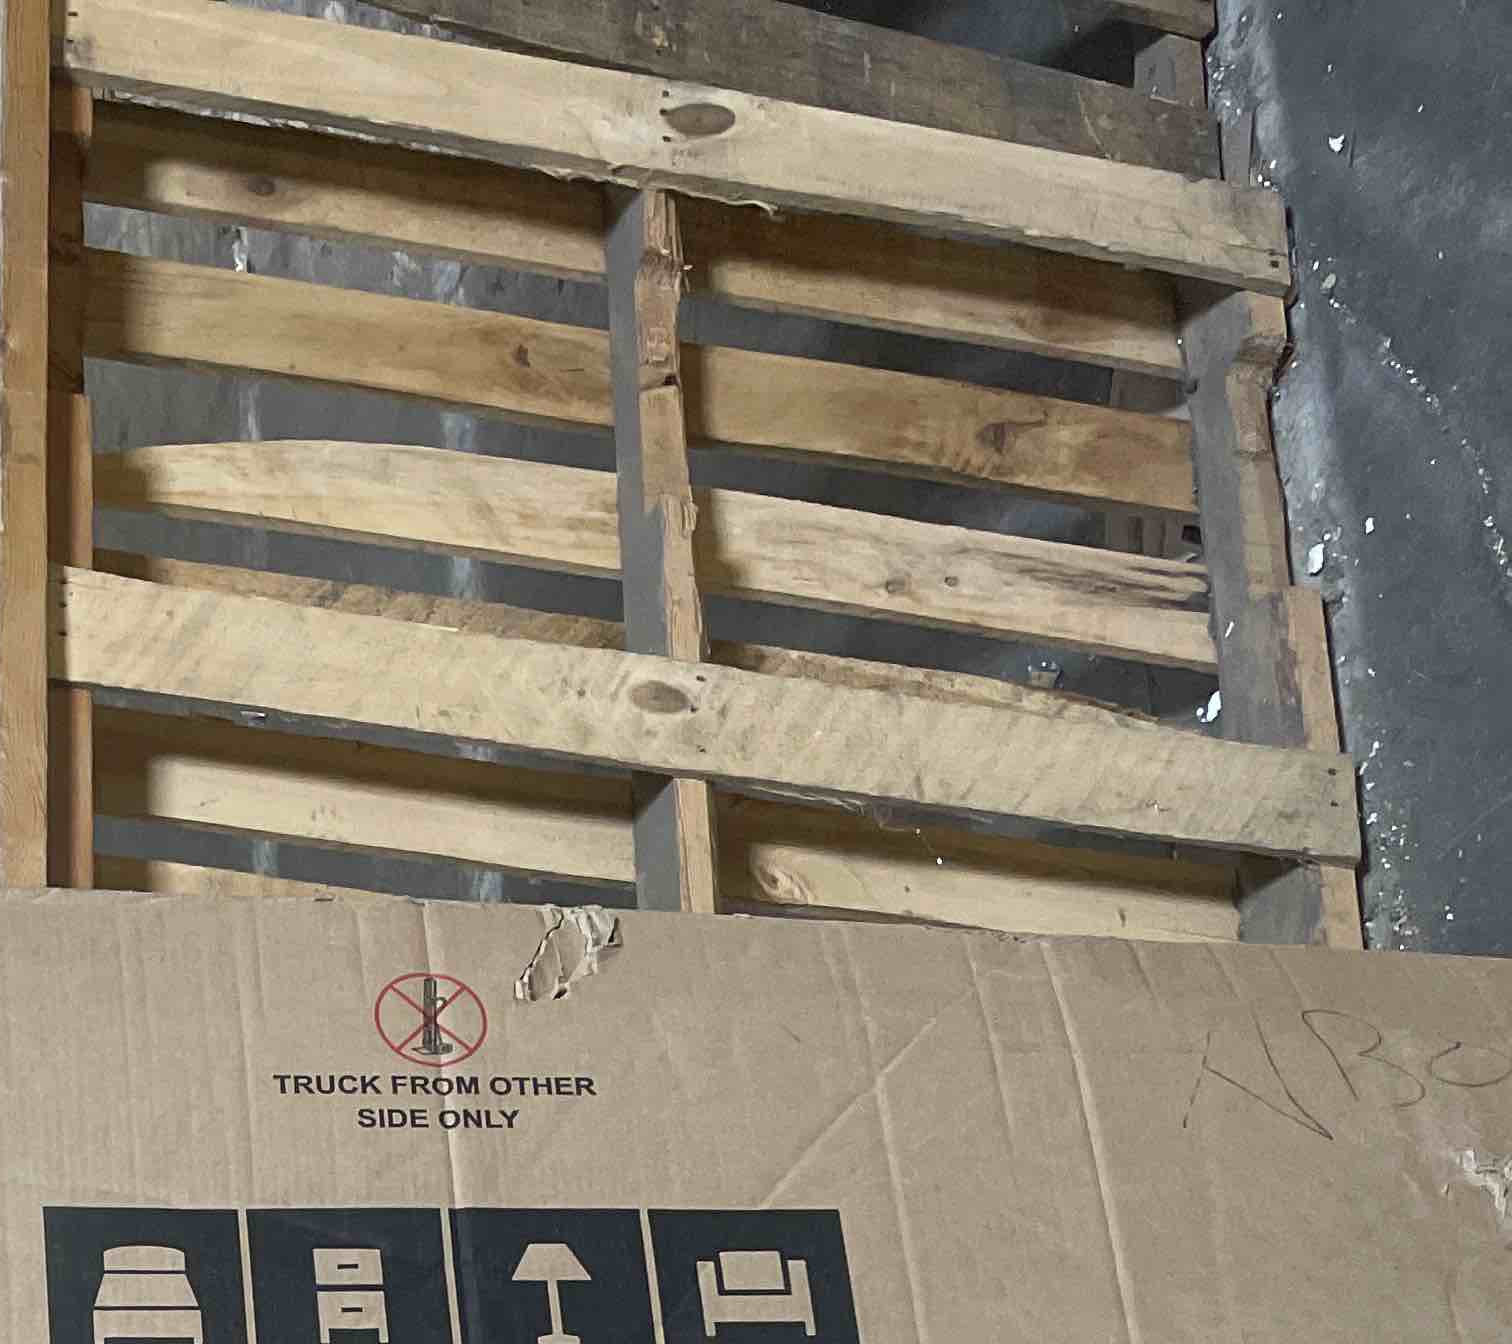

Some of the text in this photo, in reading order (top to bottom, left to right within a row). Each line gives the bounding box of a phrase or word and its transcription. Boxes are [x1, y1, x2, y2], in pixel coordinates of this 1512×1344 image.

[274, 1073, 598, 1097] TRUCK FROM OTHER
[356, 1107, 520, 1130] SIDE ONLY
